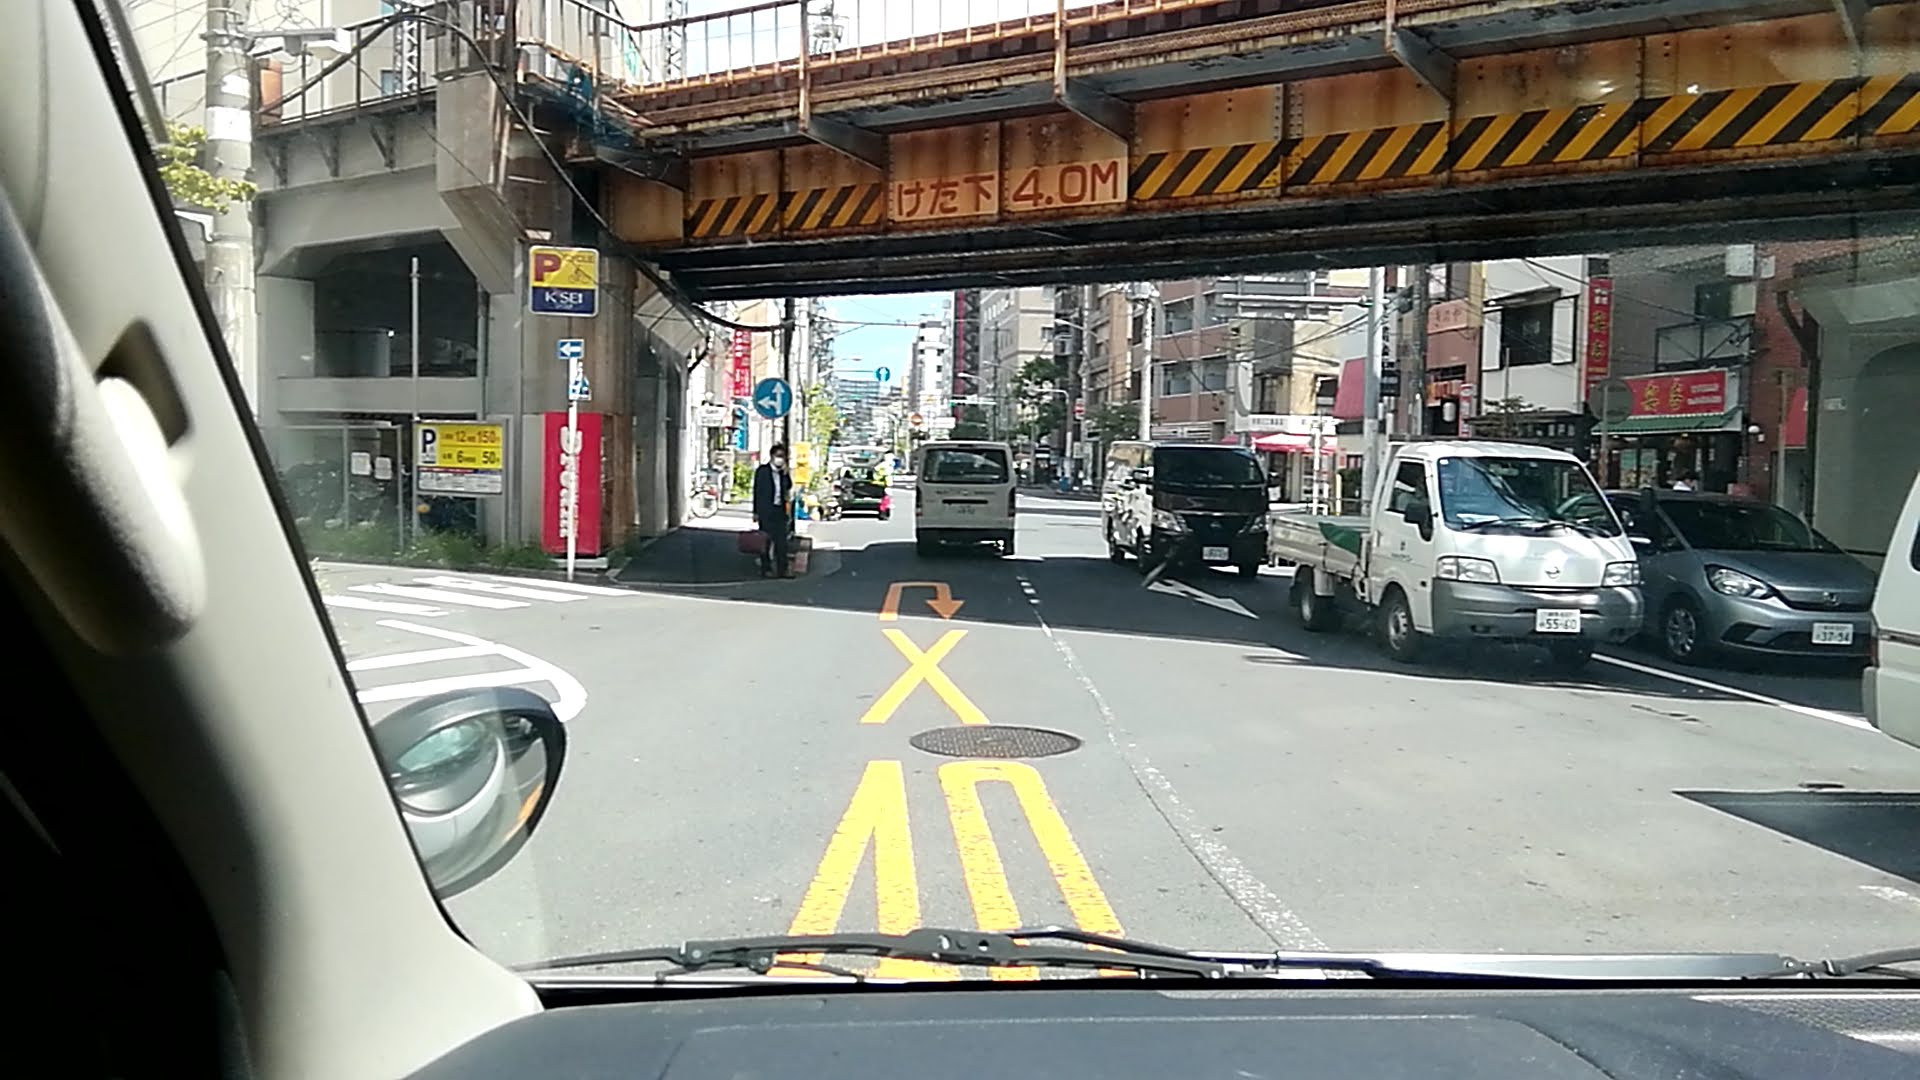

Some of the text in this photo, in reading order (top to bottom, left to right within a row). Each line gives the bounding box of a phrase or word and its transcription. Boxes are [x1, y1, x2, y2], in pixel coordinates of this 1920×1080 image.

[897, 160, 1119, 217] けた下 4.0M
[534, 253, 562, 282] P
[421, 428, 437, 454] P
